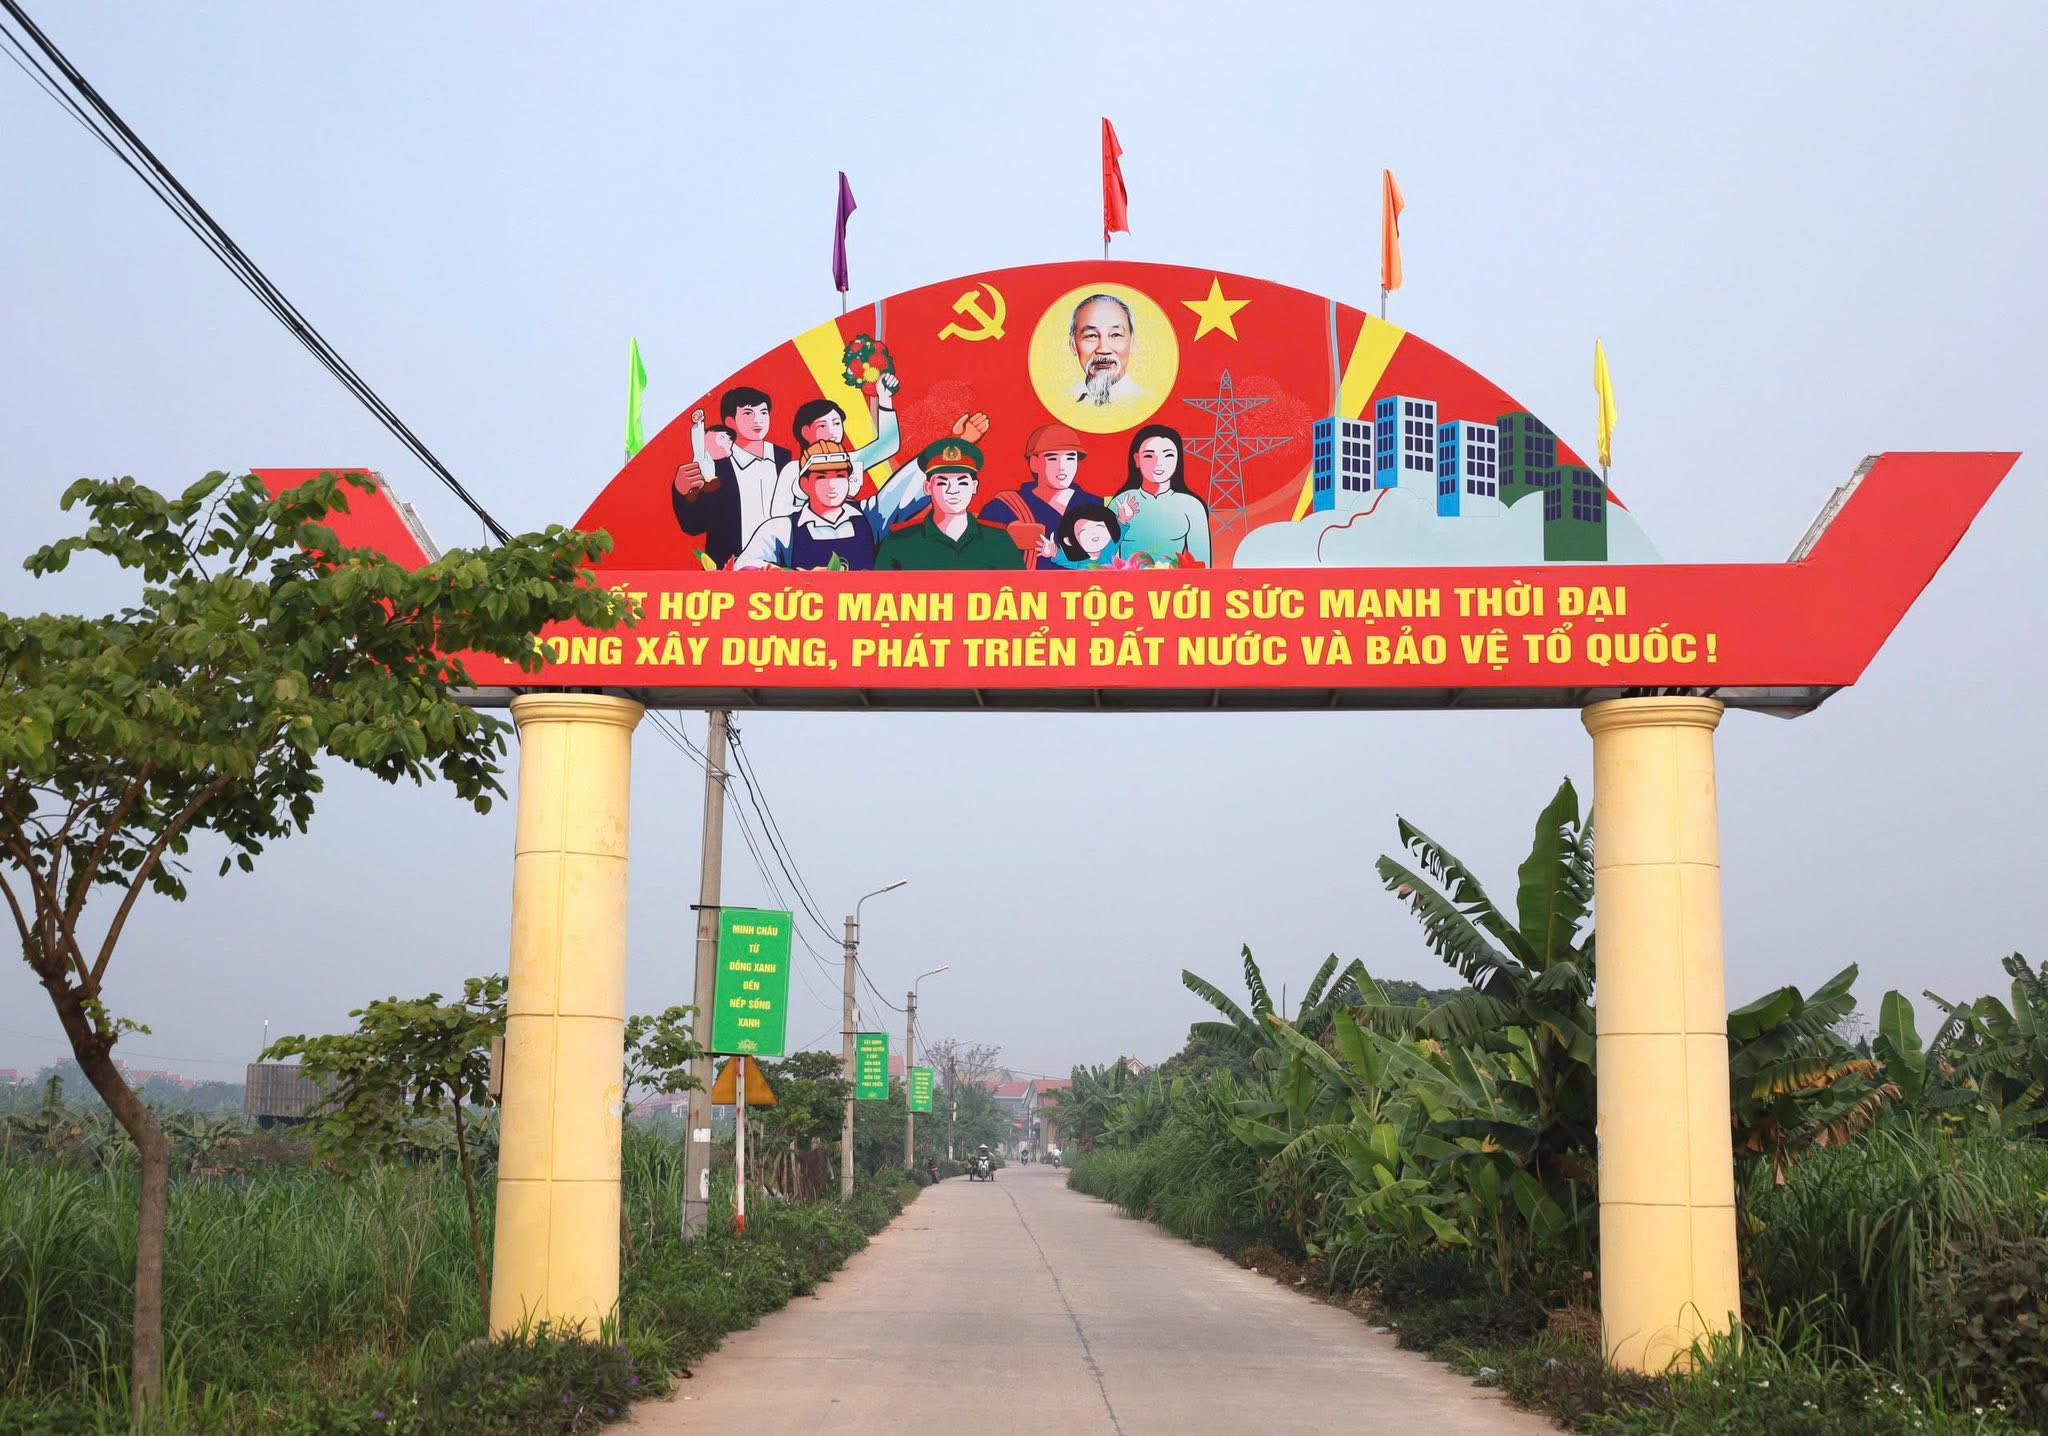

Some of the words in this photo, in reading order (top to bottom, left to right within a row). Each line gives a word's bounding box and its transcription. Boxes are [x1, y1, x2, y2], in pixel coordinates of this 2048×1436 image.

[659, 589, 735, 627] HỢP
[748, 586, 824, 622] SỨC
[837, 592, 954, 628] MẠNH
[967, 586, 1048, 622] DÂN
[1060, 584, 1134, 627] TỘC
[1147, 583, 1211, 620] VỚI
[1225, 583, 1305, 620] SỨC
[1319, 588, 1441, 625] MẠNH
[1453, 579, 1544, 617] THỜI
[1557, 586, 1627, 623] ĐẠI
[635, 630, 710, 666] XÂY
[721, 634, 838, 673] DỰNG,
[851, 632, 952, 668] PHÁT
[962, 625, 1076, 668] TRIỂN
[1088, 626, 1165, 667] ĐẤT
[1178, 630, 1287, 666] NƯỚC
[1300, 629, 1353, 666] VÀ
[1366, 625, 1447, 665] BẢO
[1460, 627, 1509, 671] VỆ
[1522, 620, 1574, 664] TỔ
[732, 925, 755, 935] MINH
[753, 963, 777, 974] XANH
[738, 1017, 760, 1029] XANH
